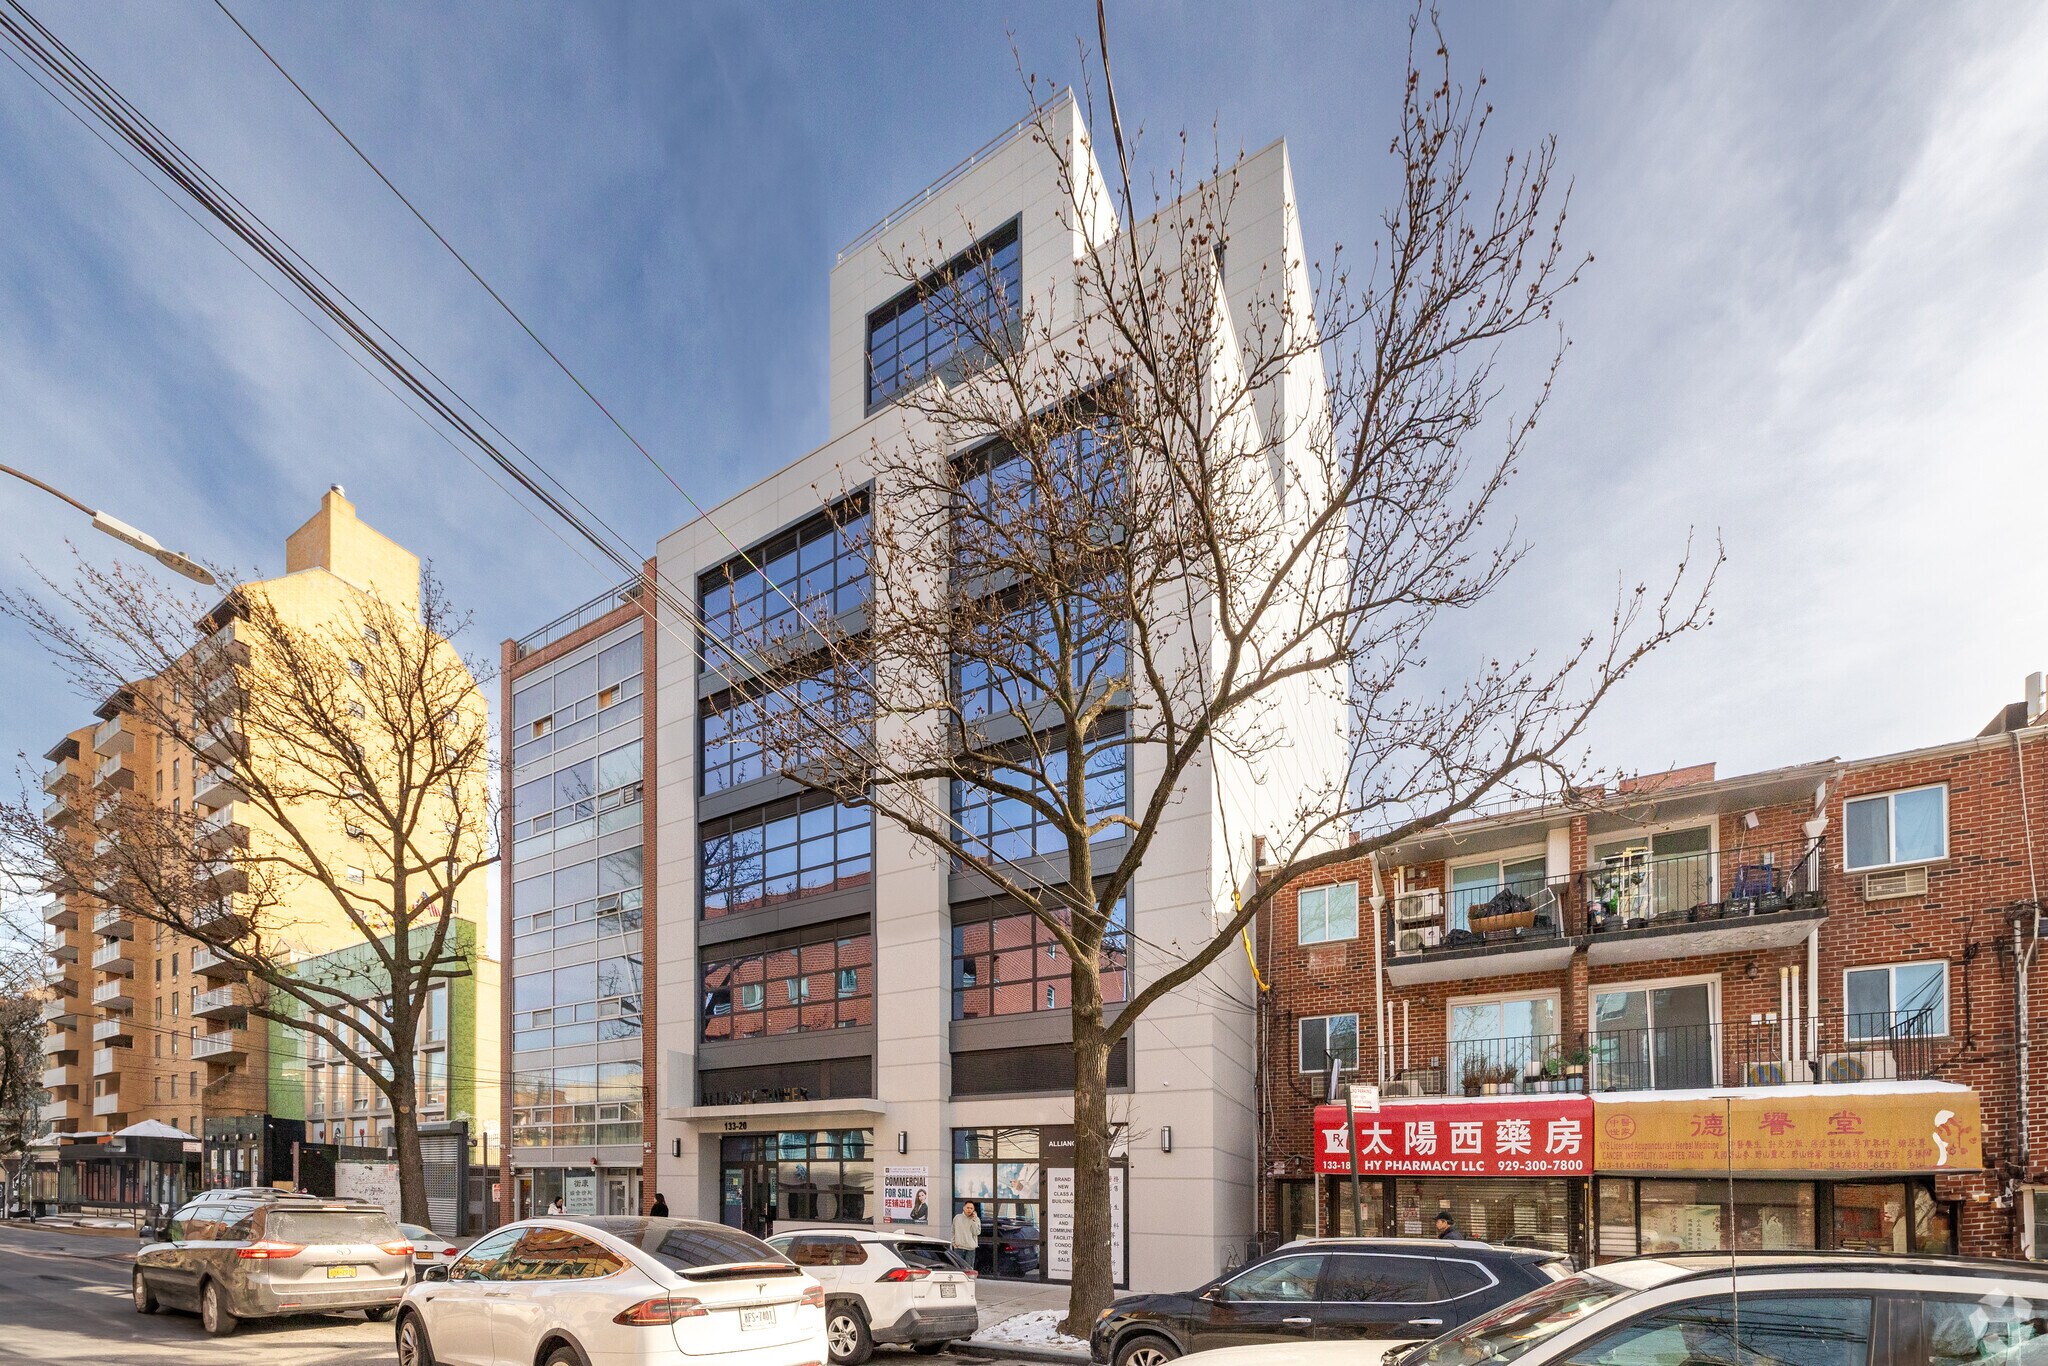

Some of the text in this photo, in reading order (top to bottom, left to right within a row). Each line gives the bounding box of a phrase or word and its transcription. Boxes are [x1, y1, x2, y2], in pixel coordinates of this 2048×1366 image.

[724, 1121, 747, 1131] 133-20
[1361, 1117, 1583, 1156] 太陽西藥房
[1610, 1141, 1634, 1150] Licensed
[1675, 1140, 1693, 1150] Herbal
[1694, 1140, 1720, 1150] Medicine
[1322, 1160, 1351, 1170] 133-18
[1364, 1160, 1485, 1172] HY PHARMACY LLC
[1497, 1159, 1584, 1172] 929-300-7800
[1808, 1161, 1827, 1169] Tel:
[884, 1176, 927, 1187] COMMERCIAL
[884, 1188, 913, 1198] FOR SALE
